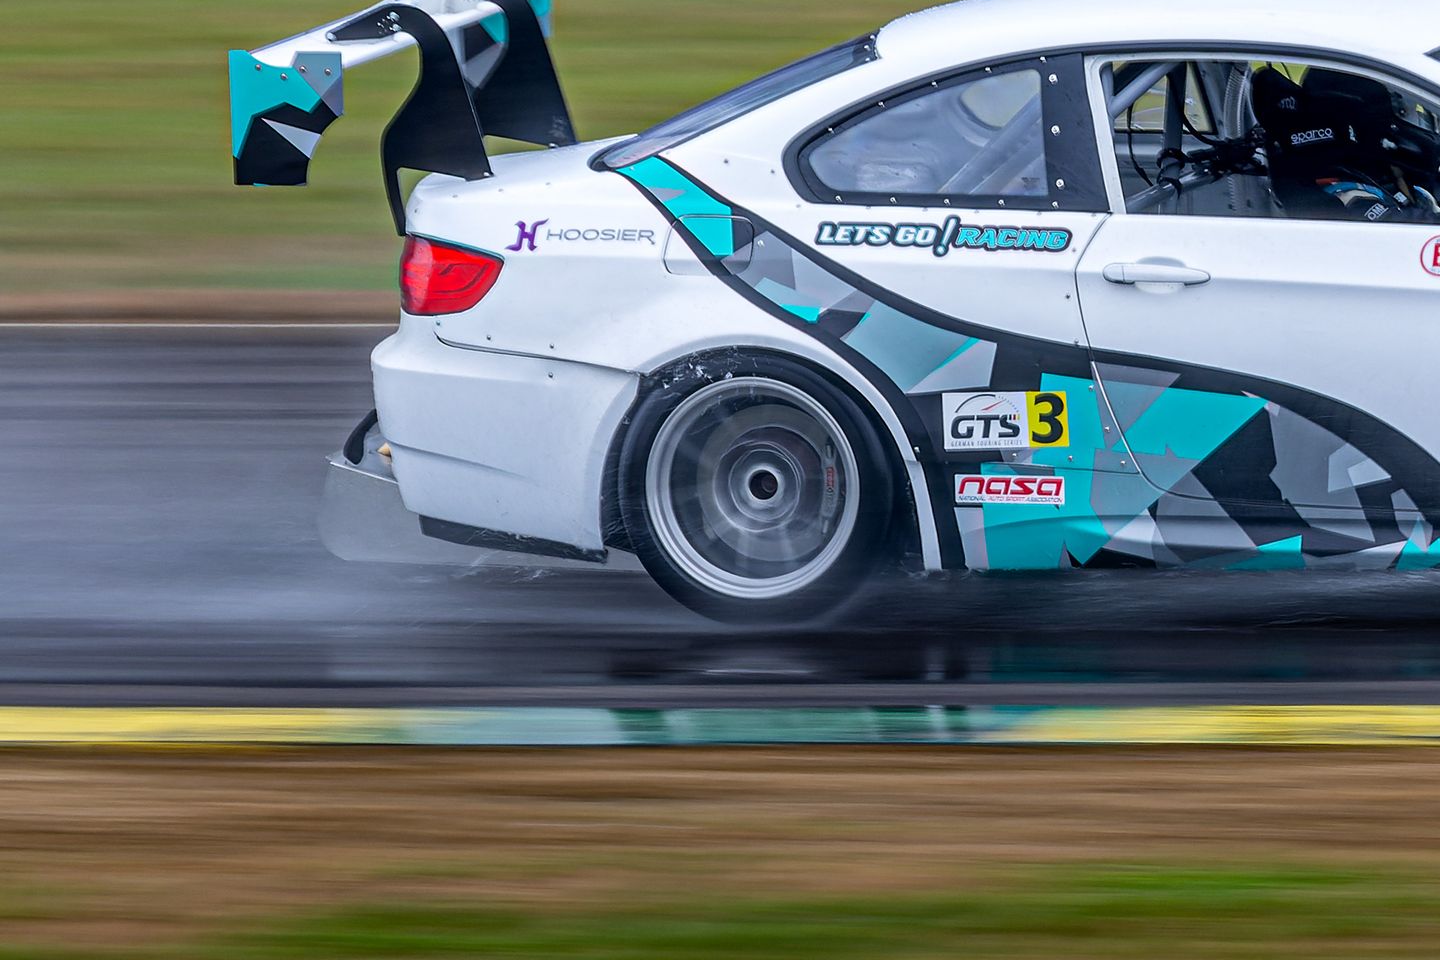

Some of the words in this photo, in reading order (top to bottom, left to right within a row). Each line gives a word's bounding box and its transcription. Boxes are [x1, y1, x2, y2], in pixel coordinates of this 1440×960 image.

[1290, 128, 1333, 144] sparco
[546, 229, 655, 245] HOOSIER
[816, 222, 893, 245] LETS
[956, 226, 1071, 251] RACING
[951, 414, 1020, 439] GTS
[1031, 393, 1064, 444] 3
